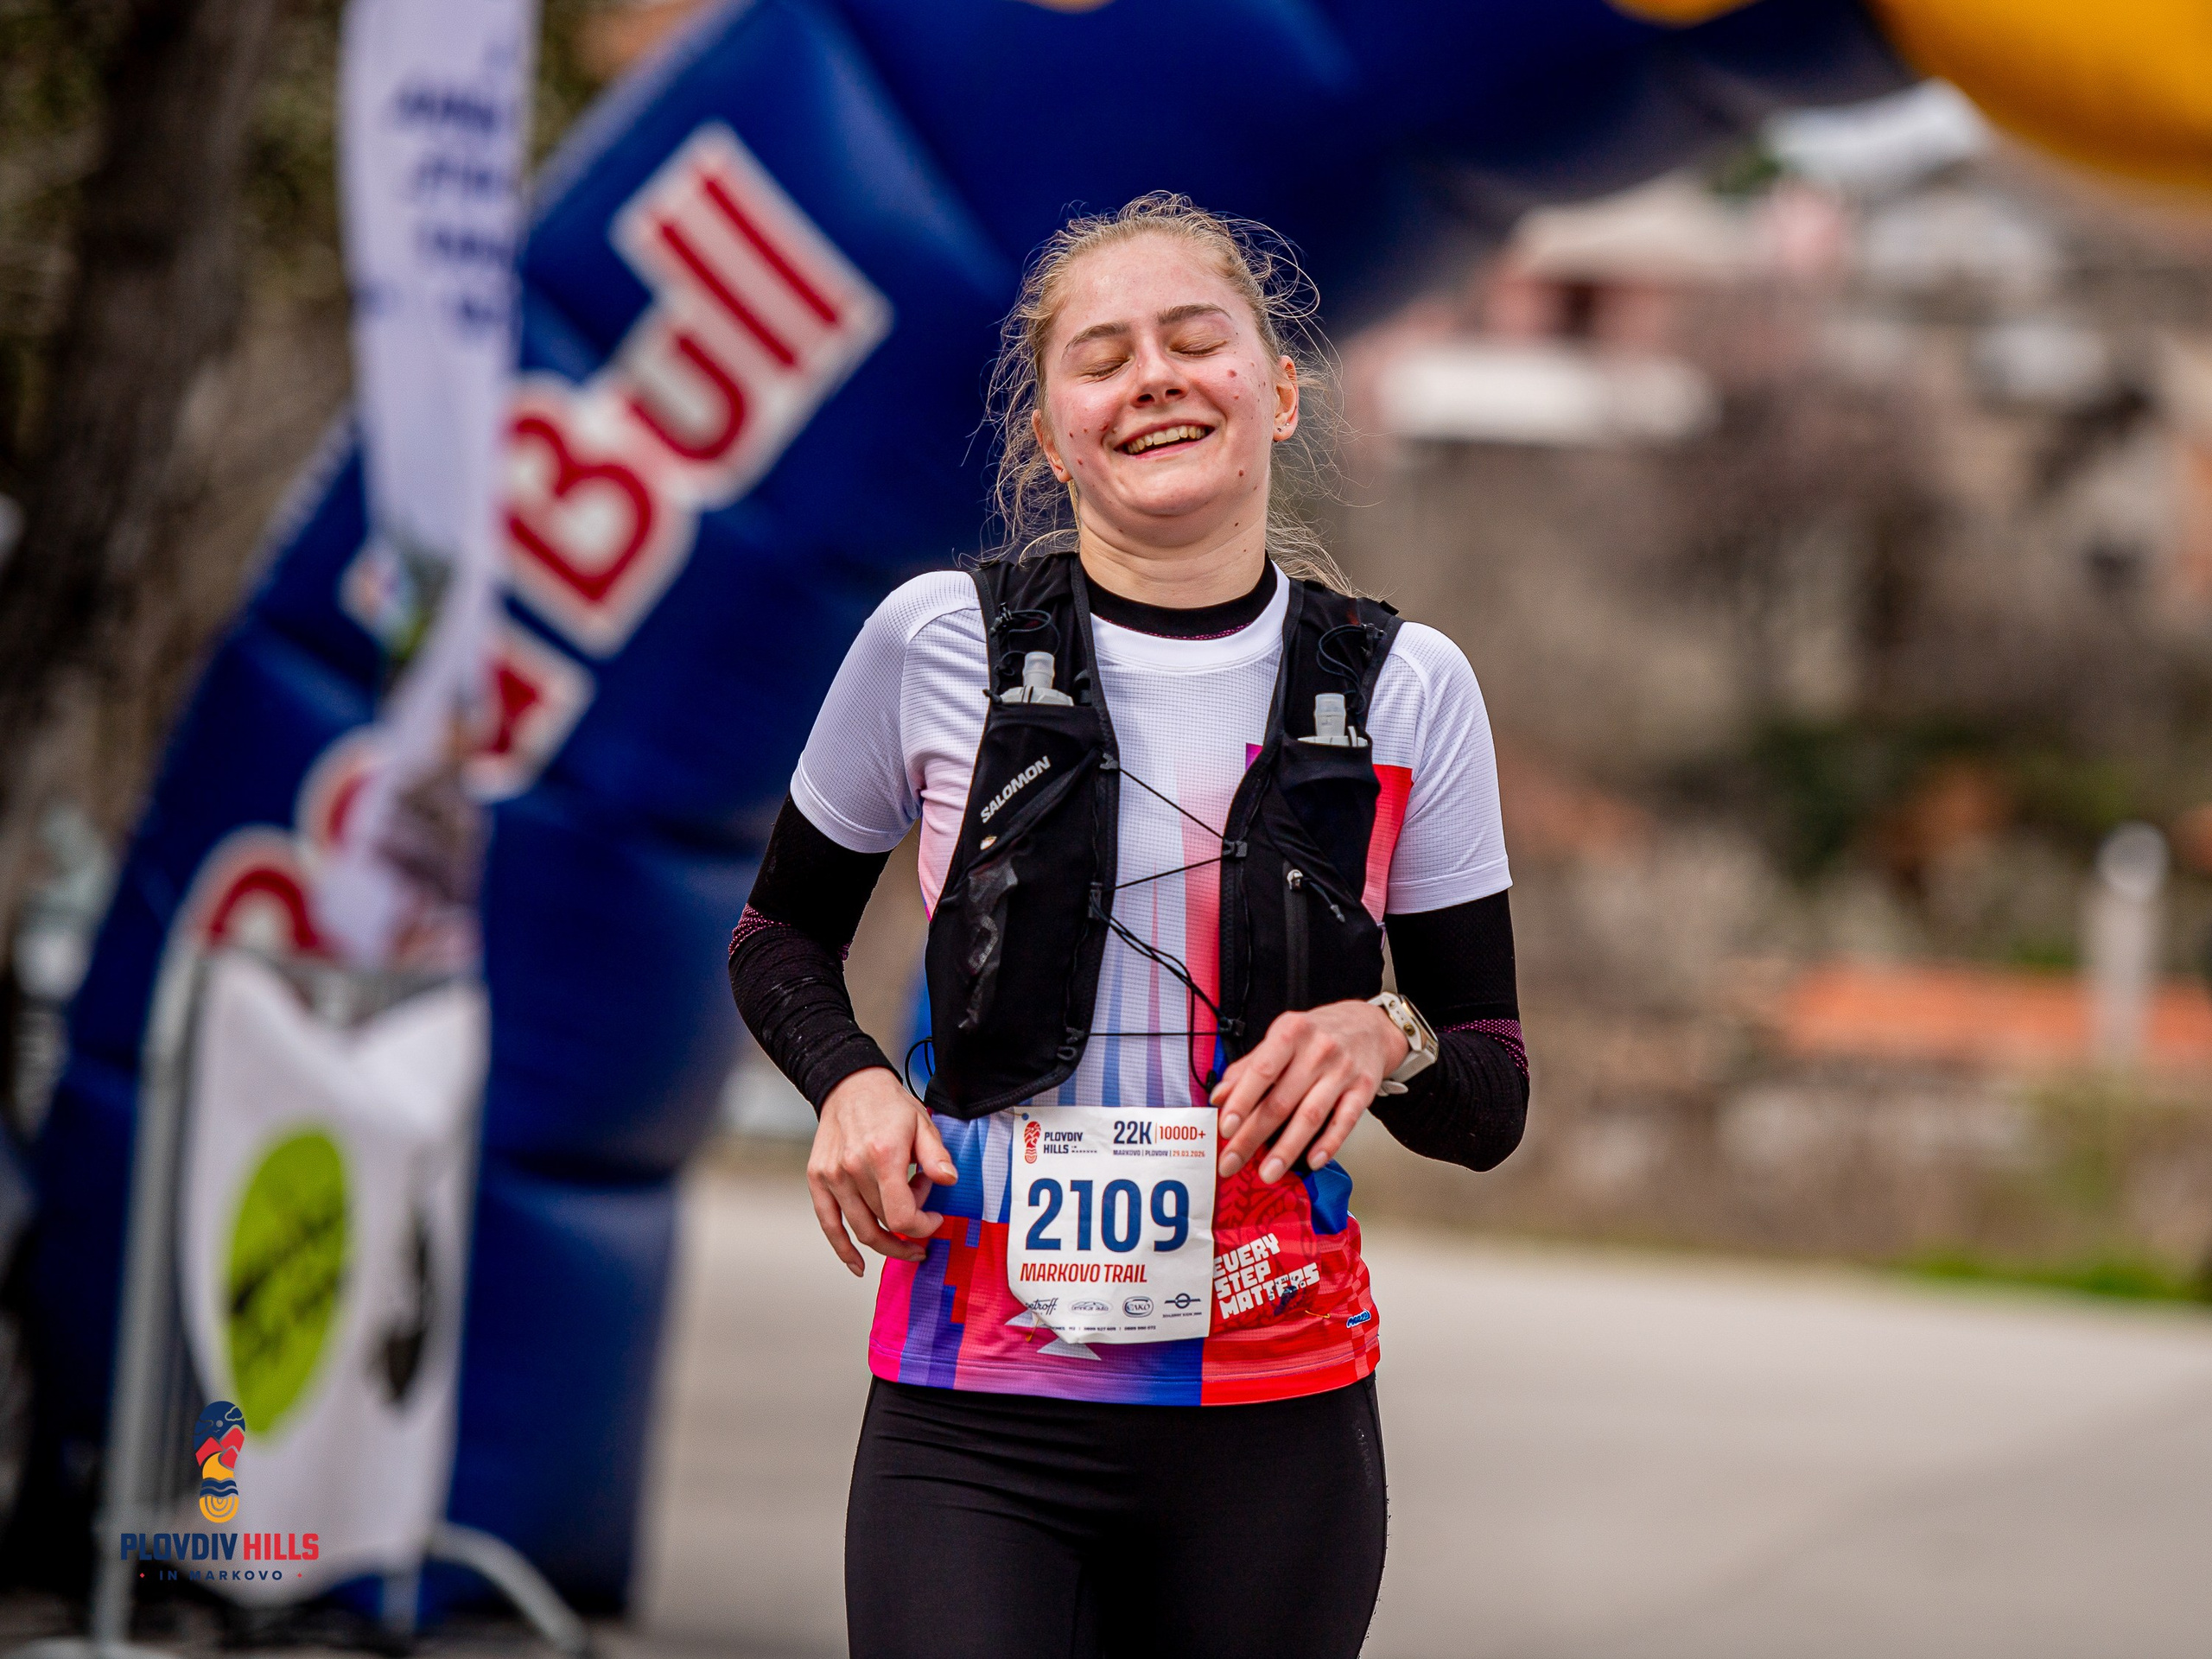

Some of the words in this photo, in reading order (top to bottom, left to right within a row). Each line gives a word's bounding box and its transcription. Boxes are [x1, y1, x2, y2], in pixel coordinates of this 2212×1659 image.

[501, 151, 864, 631] Bull
[980, 755, 1052, 823] SALOMON
[1043, 1144, 1070, 1154] HILLS
[1044, 1131, 1084, 1142] PLOVDIV
[1113, 1120, 1153, 1145] 22K
[1160, 1125, 1207, 1141] 1000D+
[1025, 1178, 1191, 1253] 2109
[1020, 1262, 1101, 1283] MARKOVO
[1104, 1263, 1148, 1283] TRAIL
[1214, 1260, 1272, 1300] STEP
[1219, 1262, 1320, 1320] MATTERS
